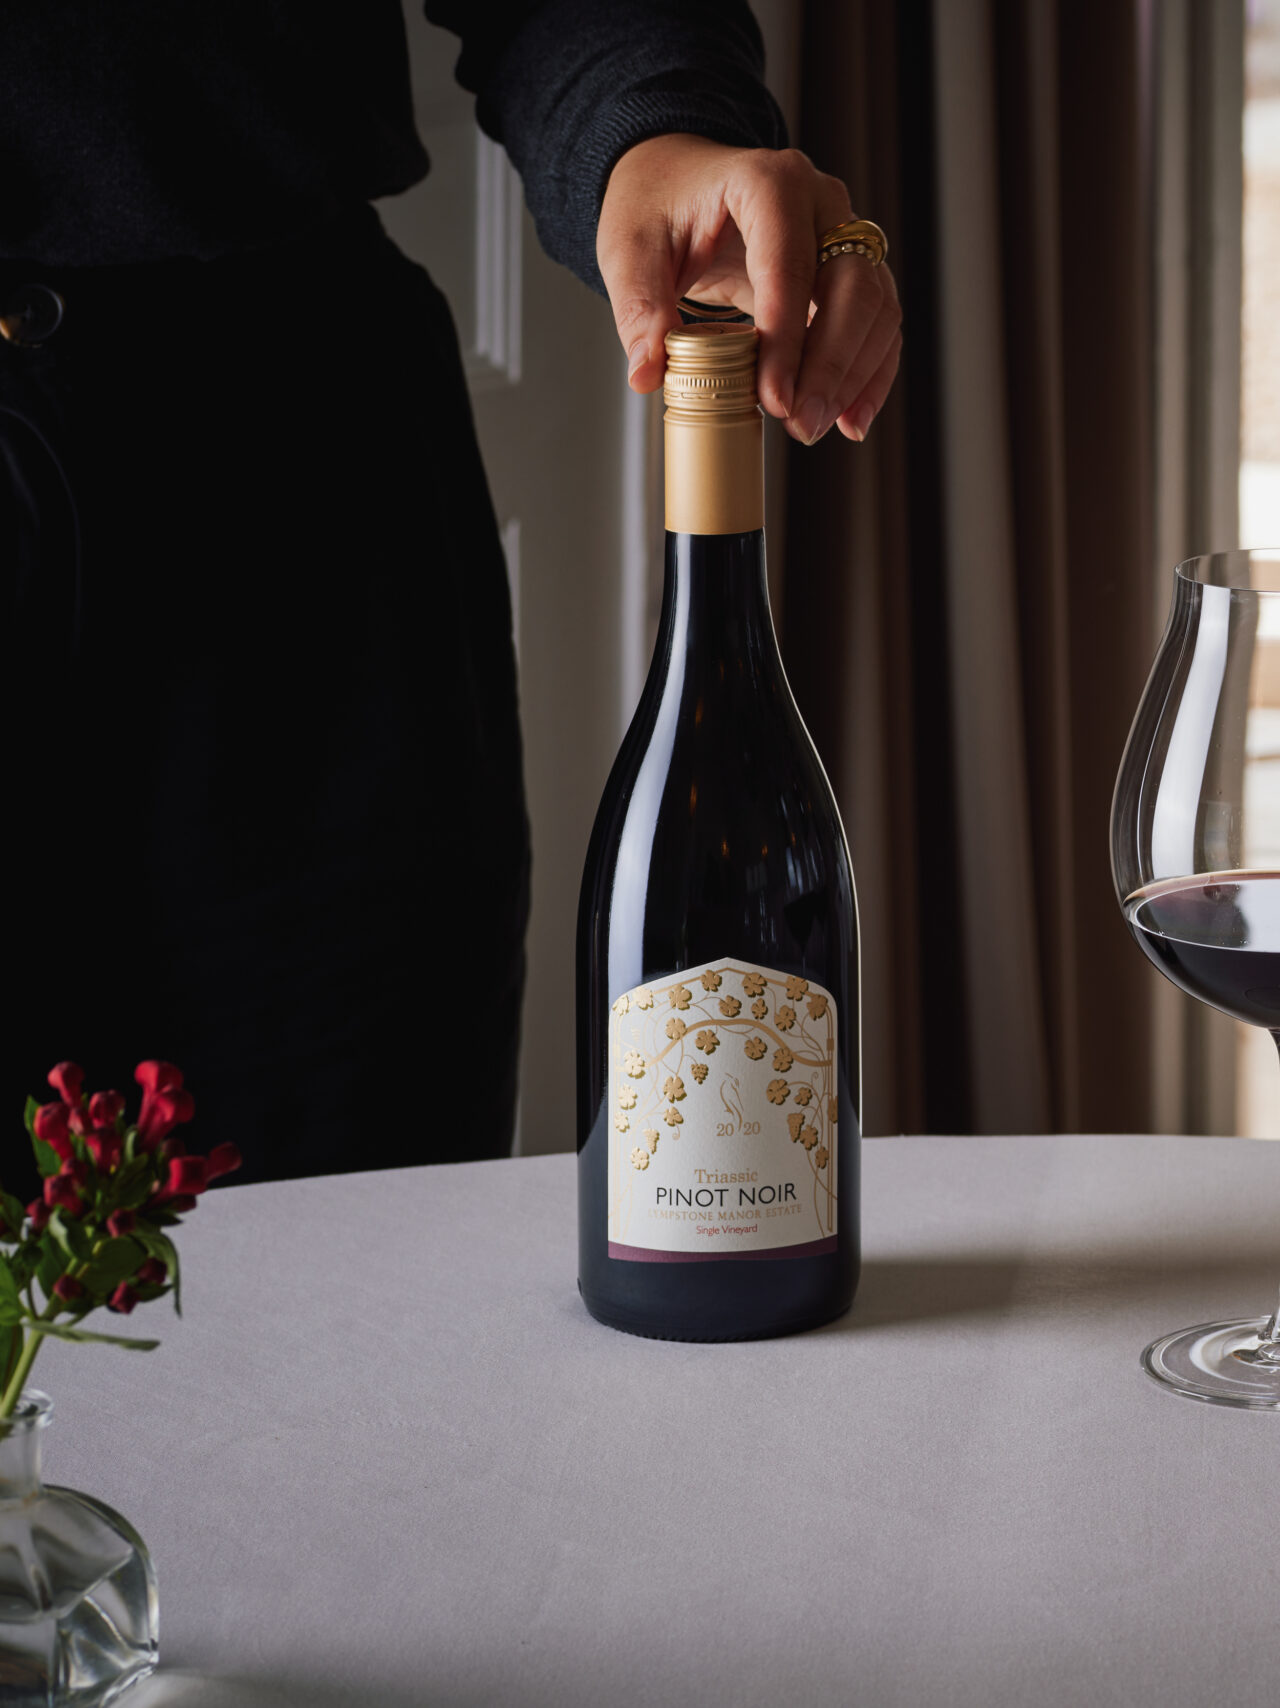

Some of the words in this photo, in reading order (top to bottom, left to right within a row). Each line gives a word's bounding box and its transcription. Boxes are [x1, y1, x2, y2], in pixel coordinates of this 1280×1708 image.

[716, 1122, 735, 1137] 20
[743, 1121, 761, 1136] 20
[694, 1168, 759, 1184] Triassic
[656, 1186, 729, 1207] PINOT
[739, 1182, 797, 1205] NOIR
[717, 1208, 761, 1221] MANOR
[766, 1203, 802, 1217] ESTATE
[696, 1225, 720, 1236] Single
[721, 1224, 758, 1236] Vineyard
